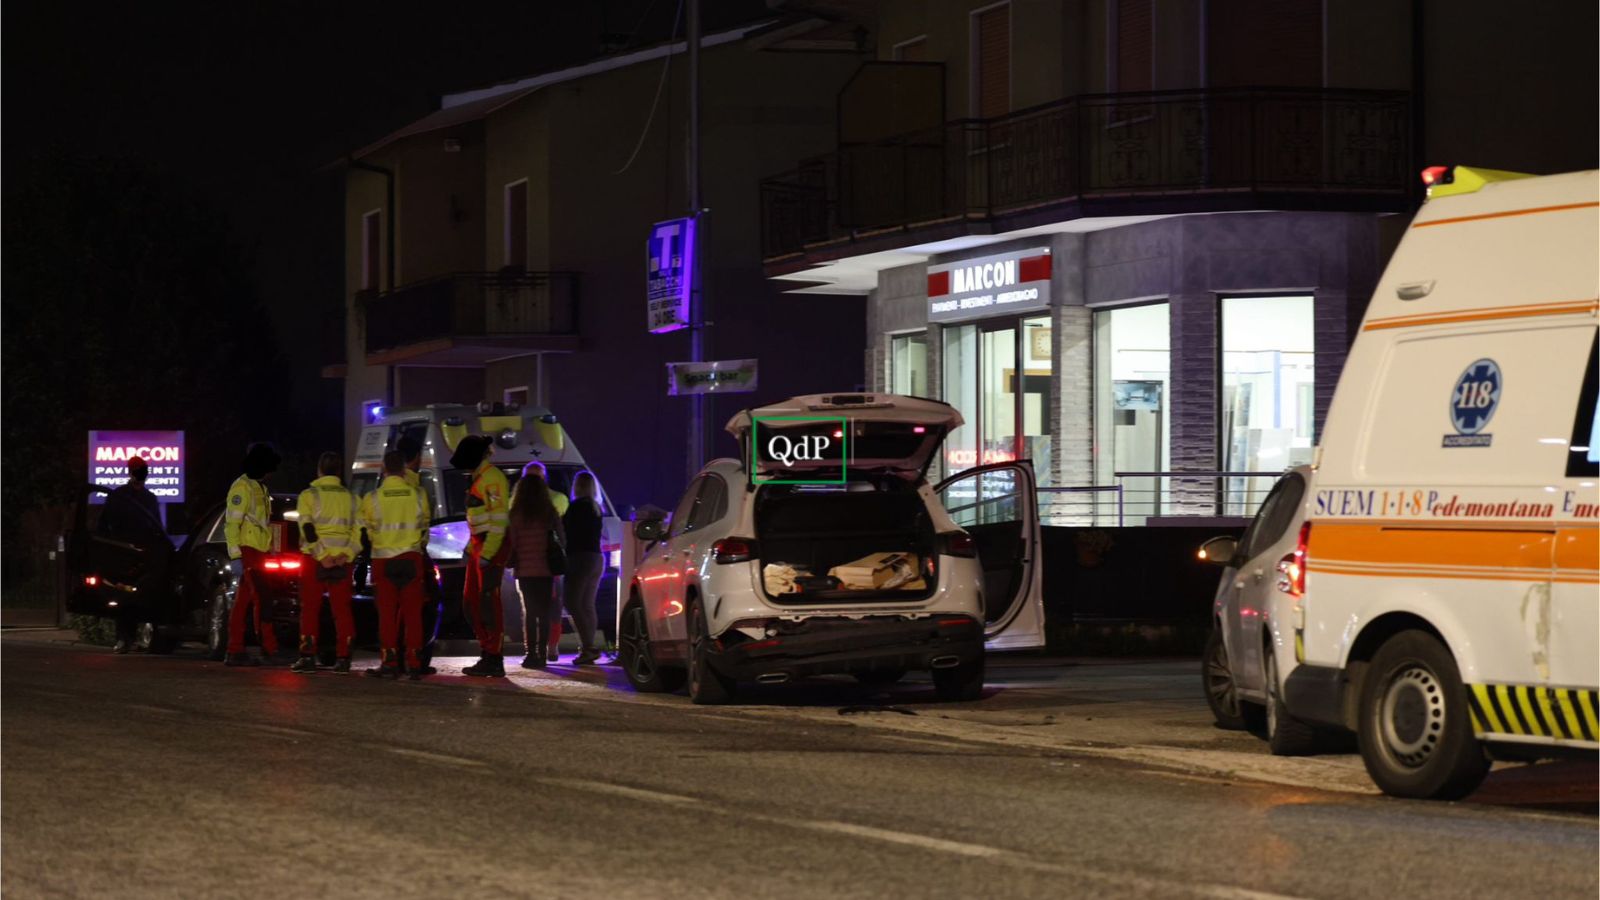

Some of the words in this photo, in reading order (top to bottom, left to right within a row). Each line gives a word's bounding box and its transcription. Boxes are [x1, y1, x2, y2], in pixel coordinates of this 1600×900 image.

[655, 224, 680, 270] T
[952, 259, 1015, 293] MARCON
[719, 371, 738, 381] bar
[1457, 380, 1493, 409] 118
[95, 466, 179, 475] PAVIENTI
[1315, 490, 1374, 515] SUEM
[1427, 490, 1553, 517] Pedemontana
